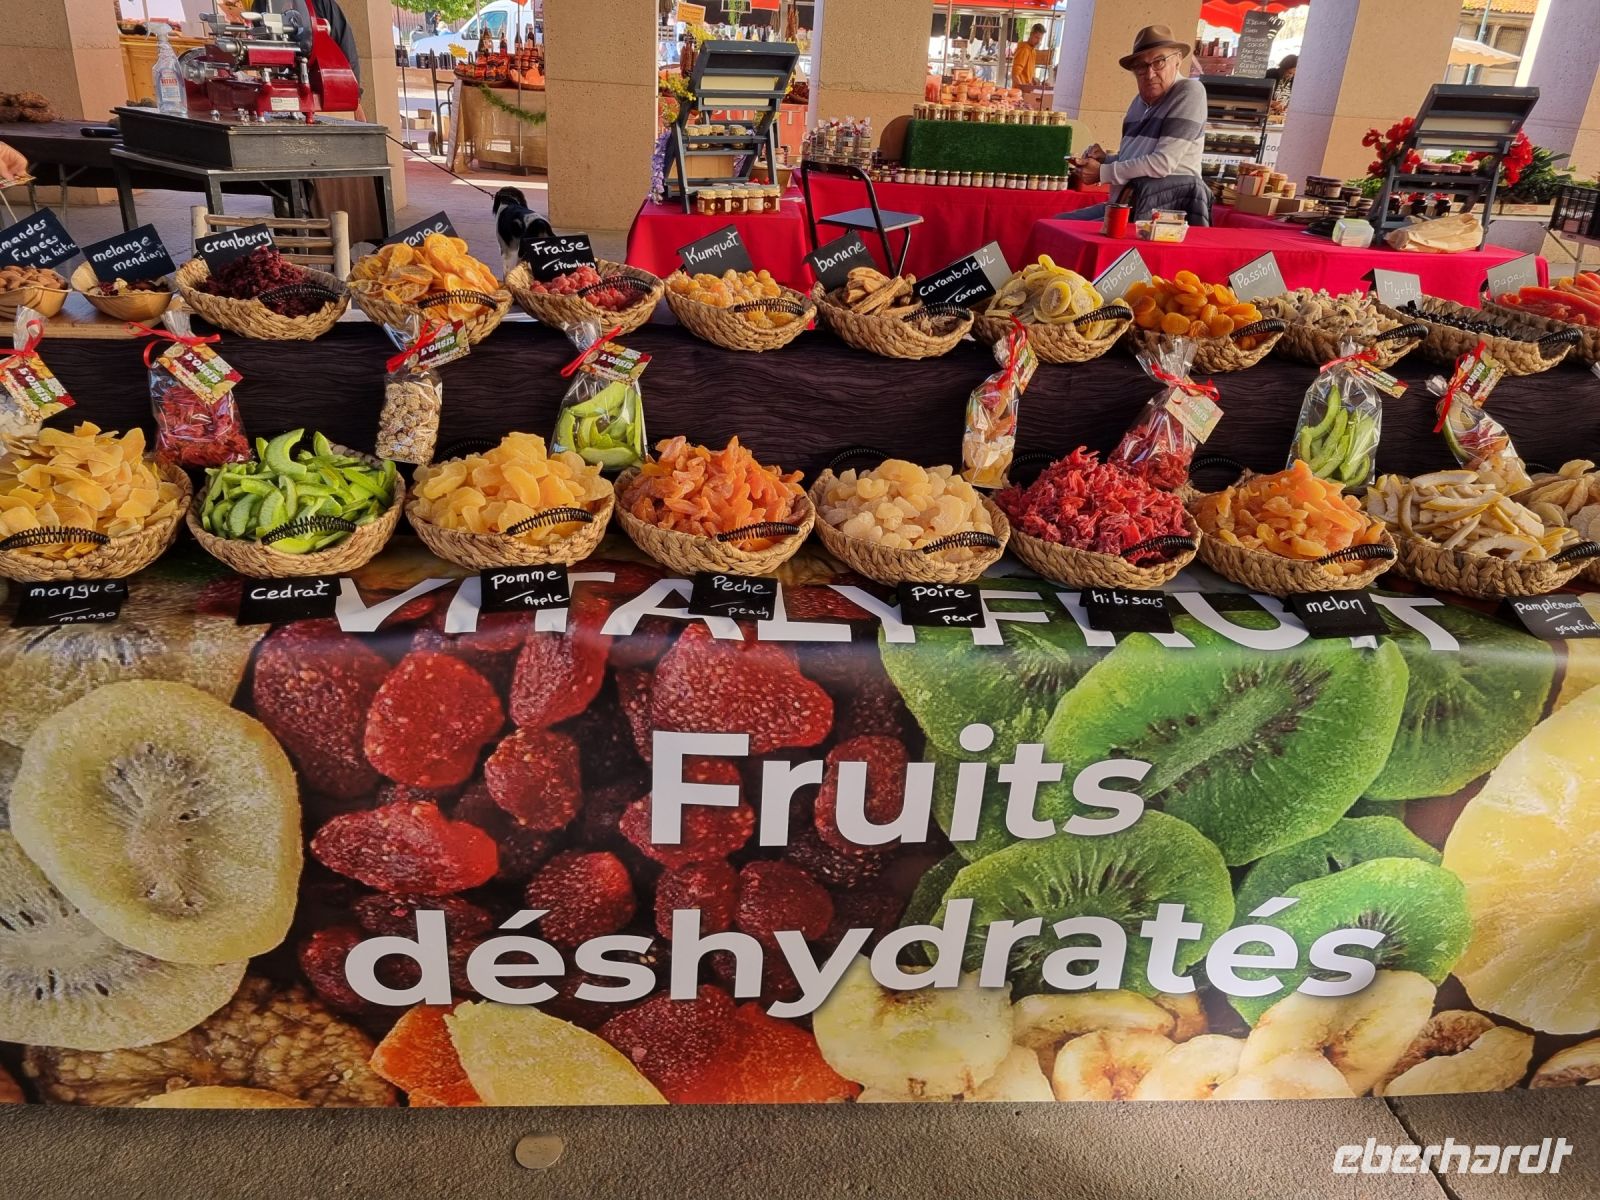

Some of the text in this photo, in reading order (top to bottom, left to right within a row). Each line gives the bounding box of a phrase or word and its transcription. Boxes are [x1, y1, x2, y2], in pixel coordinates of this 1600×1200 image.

[0, 219, 47, 254] mandes
[402, 221, 448, 249] range
[531, 239, 590, 256] Fraise
[685, 232, 739, 265] Kumquat
[92, 236, 151, 264] melange
[814, 241, 867, 273] banane
[919, 260, 980, 297] Carambole
[1234, 262, 1276, 290] Passion
[30, 583, 124, 600] mangue
[250, 579, 331, 602] Cedrat
[1091, 590, 1163, 608] hibiscus
[60, 611, 116, 623] mango
[942, 613, 979, 624] pear
[1306, 596, 1367, 615] melon
[650, 723, 1154, 847] Fruits
[344, 896, 1387, 1018] déshydratés
